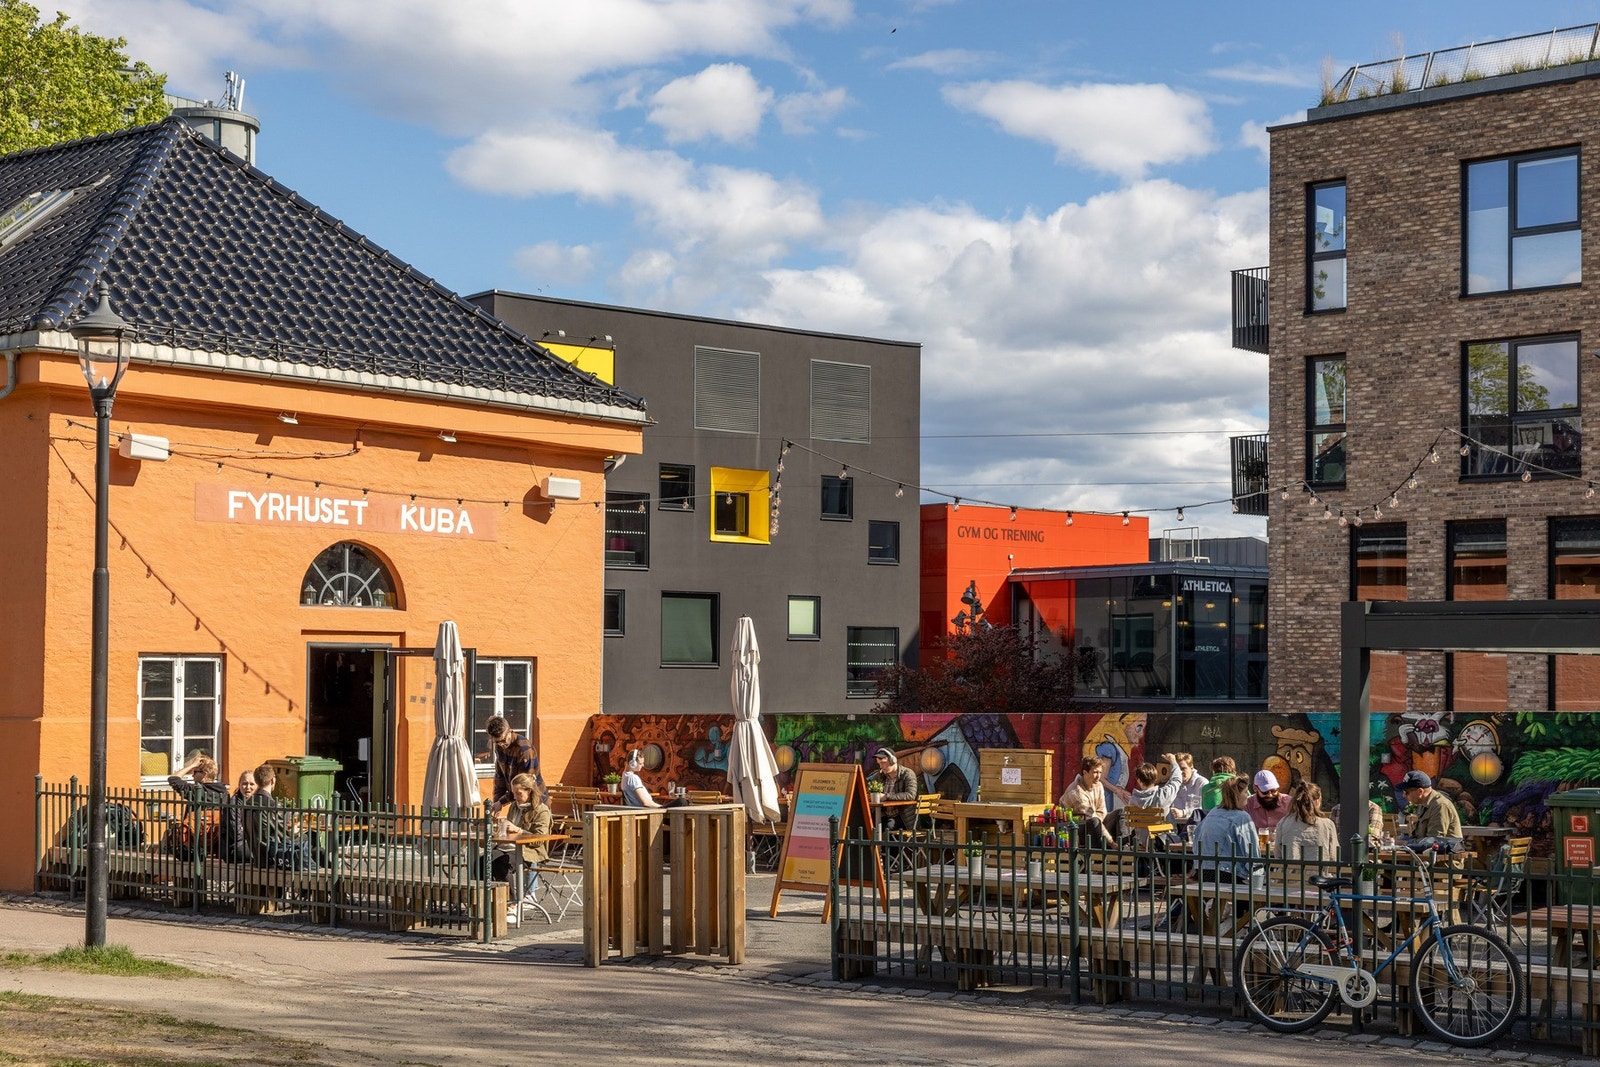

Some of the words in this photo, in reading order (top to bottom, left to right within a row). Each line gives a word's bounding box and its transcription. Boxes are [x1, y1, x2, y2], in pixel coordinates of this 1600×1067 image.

[228, 490, 368, 525] FYRHUSET
[401, 504, 474, 534] KUBA
[957, 525, 981, 539] GYM
[983, 527, 998, 540] OG
[1001, 528, 1045, 543] TRENING
[1182, 580, 1232, 593] ATHLETICA
